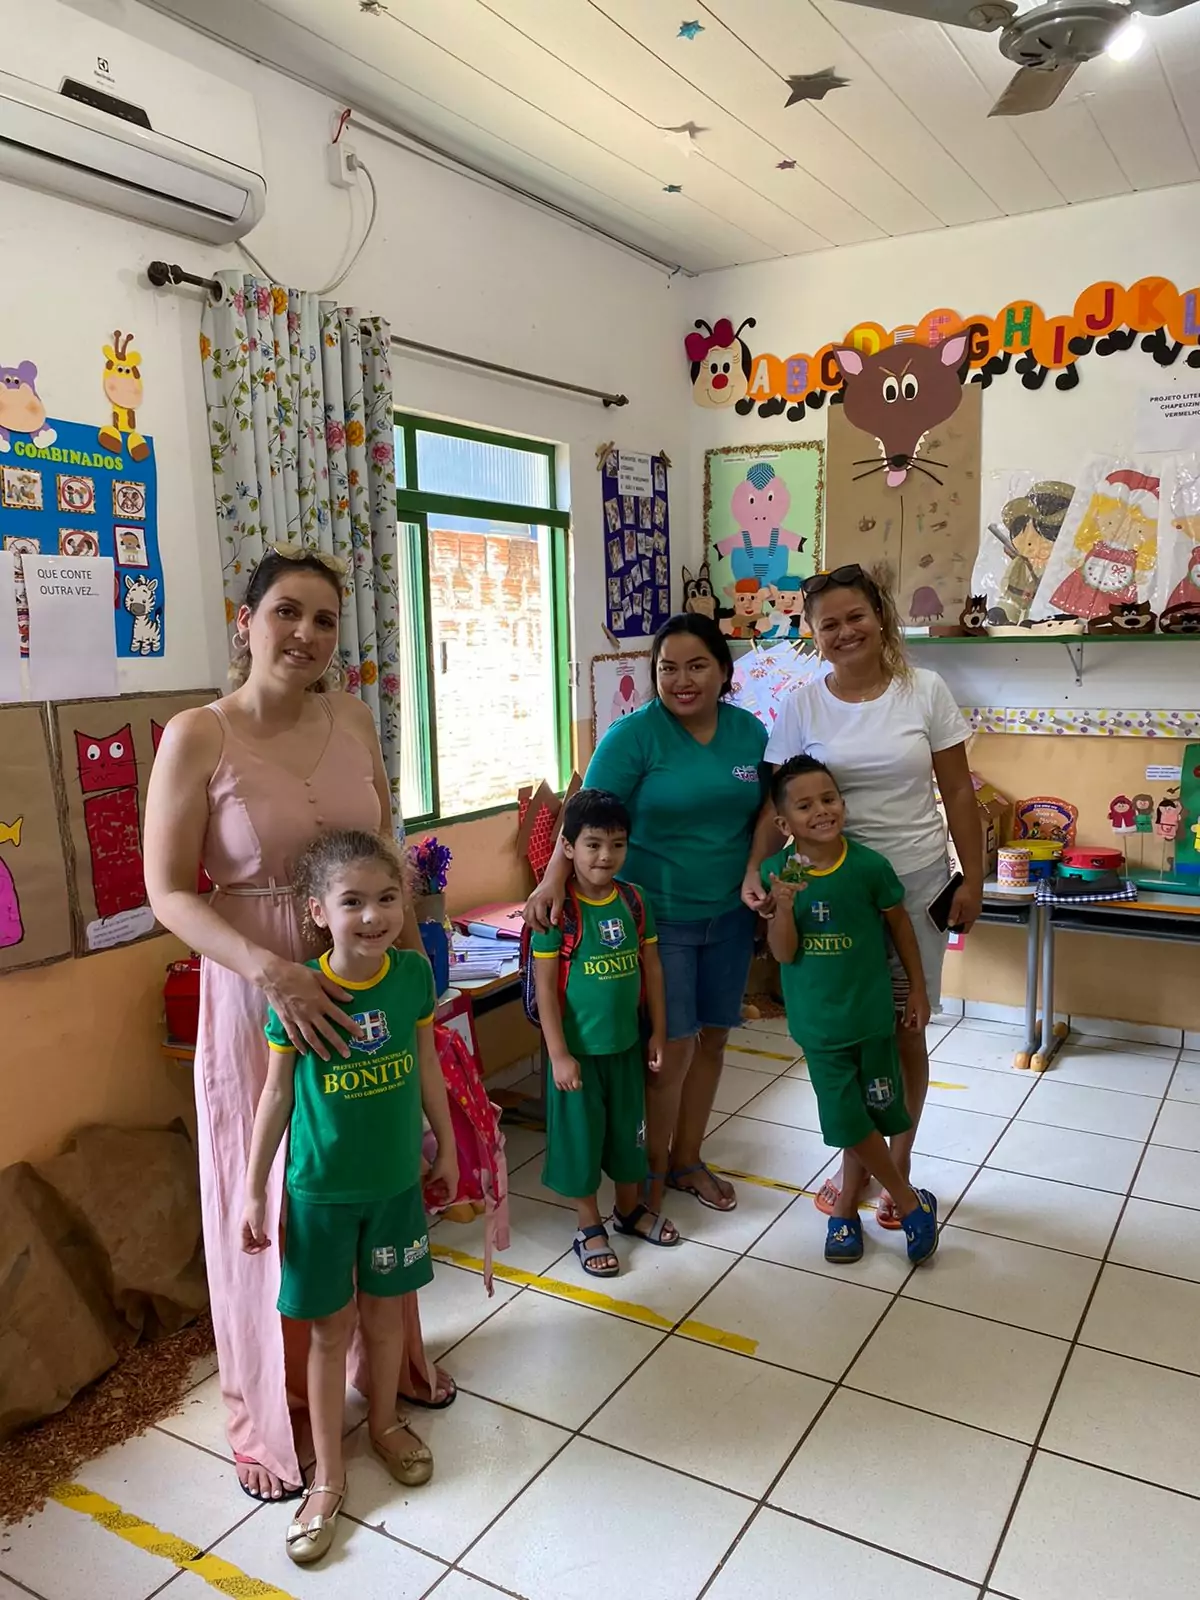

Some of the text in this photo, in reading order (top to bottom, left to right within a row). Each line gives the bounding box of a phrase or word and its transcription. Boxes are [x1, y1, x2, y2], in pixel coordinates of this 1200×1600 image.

[750, 359, 771, 394] A
[786, 358, 809, 395] B
[820, 350, 844, 387] C
[969, 322, 991, 361] G
[1003, 306, 1034, 347] H
[1053, 325, 1066, 364] I
[1085, 288, 1115, 331] J
[1137, 282, 1171, 326] K
[1150, 394, 1181, 402] PROJETO
[1160, 401, 1200, 410] CHAPEUZIN
[14, 440, 124, 472] COMBINADOS
[37, 568, 93, 580] QUE CONTE
[40, 585, 74, 596] OUTRA
[803, 936, 853, 951] ONITO
[323, 1054, 413, 1094] BONITO
